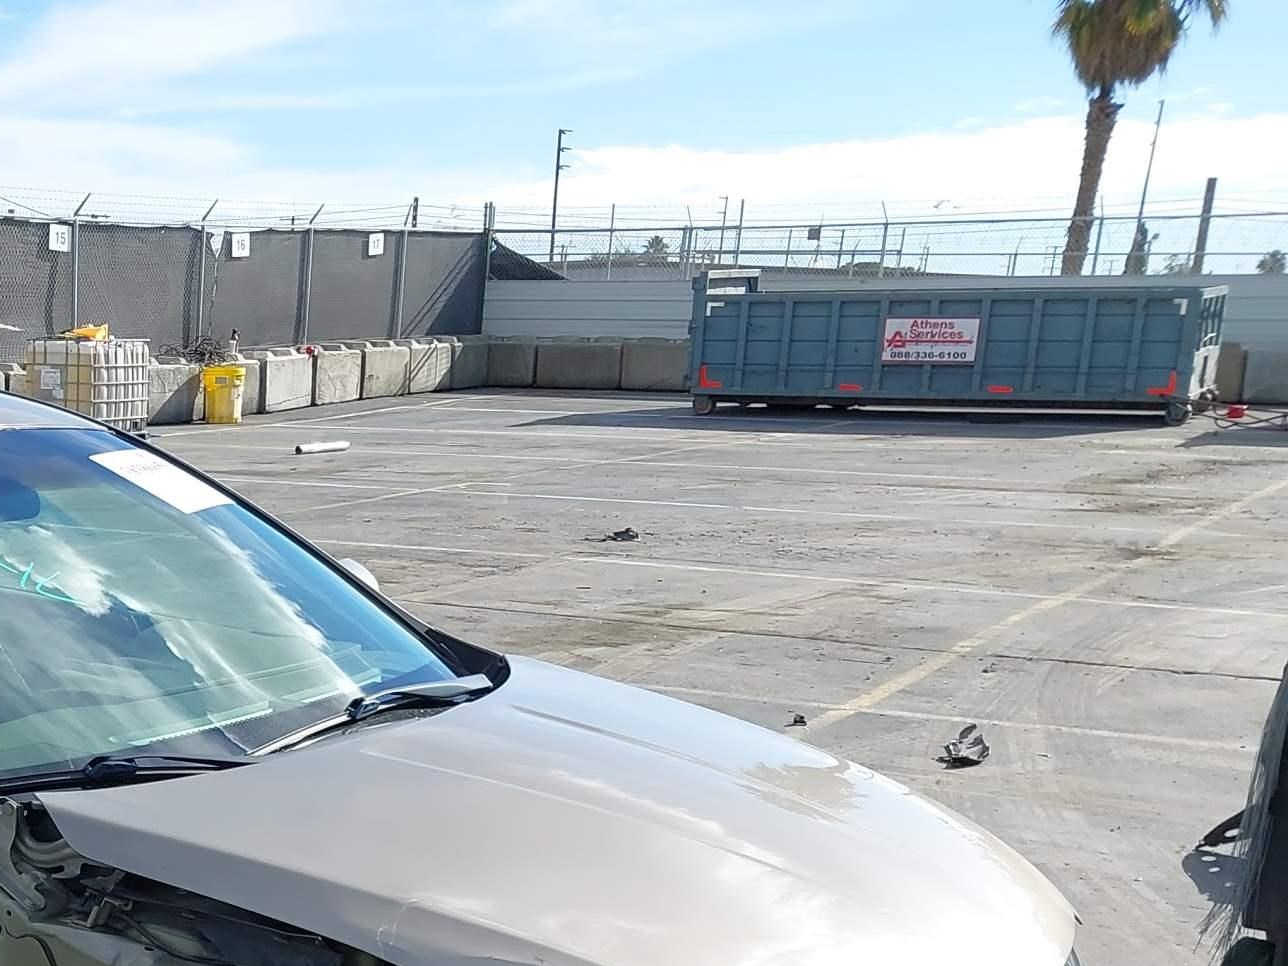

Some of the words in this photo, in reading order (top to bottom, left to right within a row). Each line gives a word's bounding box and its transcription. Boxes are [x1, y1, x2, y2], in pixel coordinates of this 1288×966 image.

[55, 231, 66, 245] 15
[910, 319, 956, 330] Athens
[908, 328, 964, 340] Services
